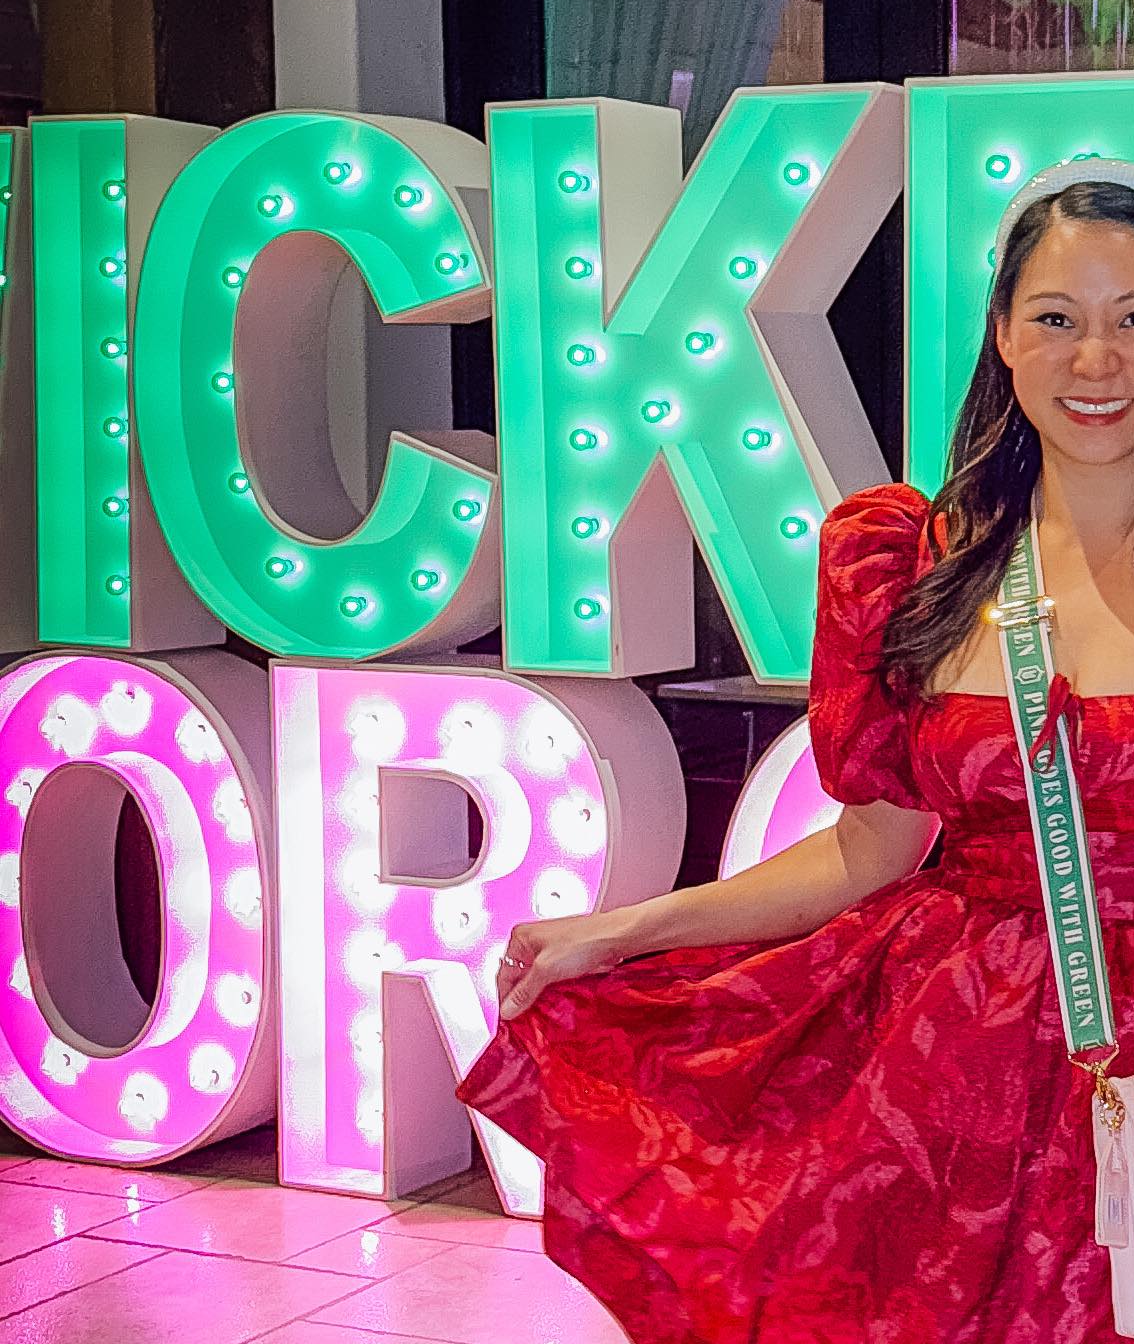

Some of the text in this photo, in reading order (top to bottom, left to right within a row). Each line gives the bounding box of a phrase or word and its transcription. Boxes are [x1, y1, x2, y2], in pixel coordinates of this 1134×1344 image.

[1036, 748, 1064, 807] GOES
[1046, 812, 1073, 876] GOOD
[1057, 880, 1085, 944] WITH
[1067, 951, 1096, 1028] GREEN
